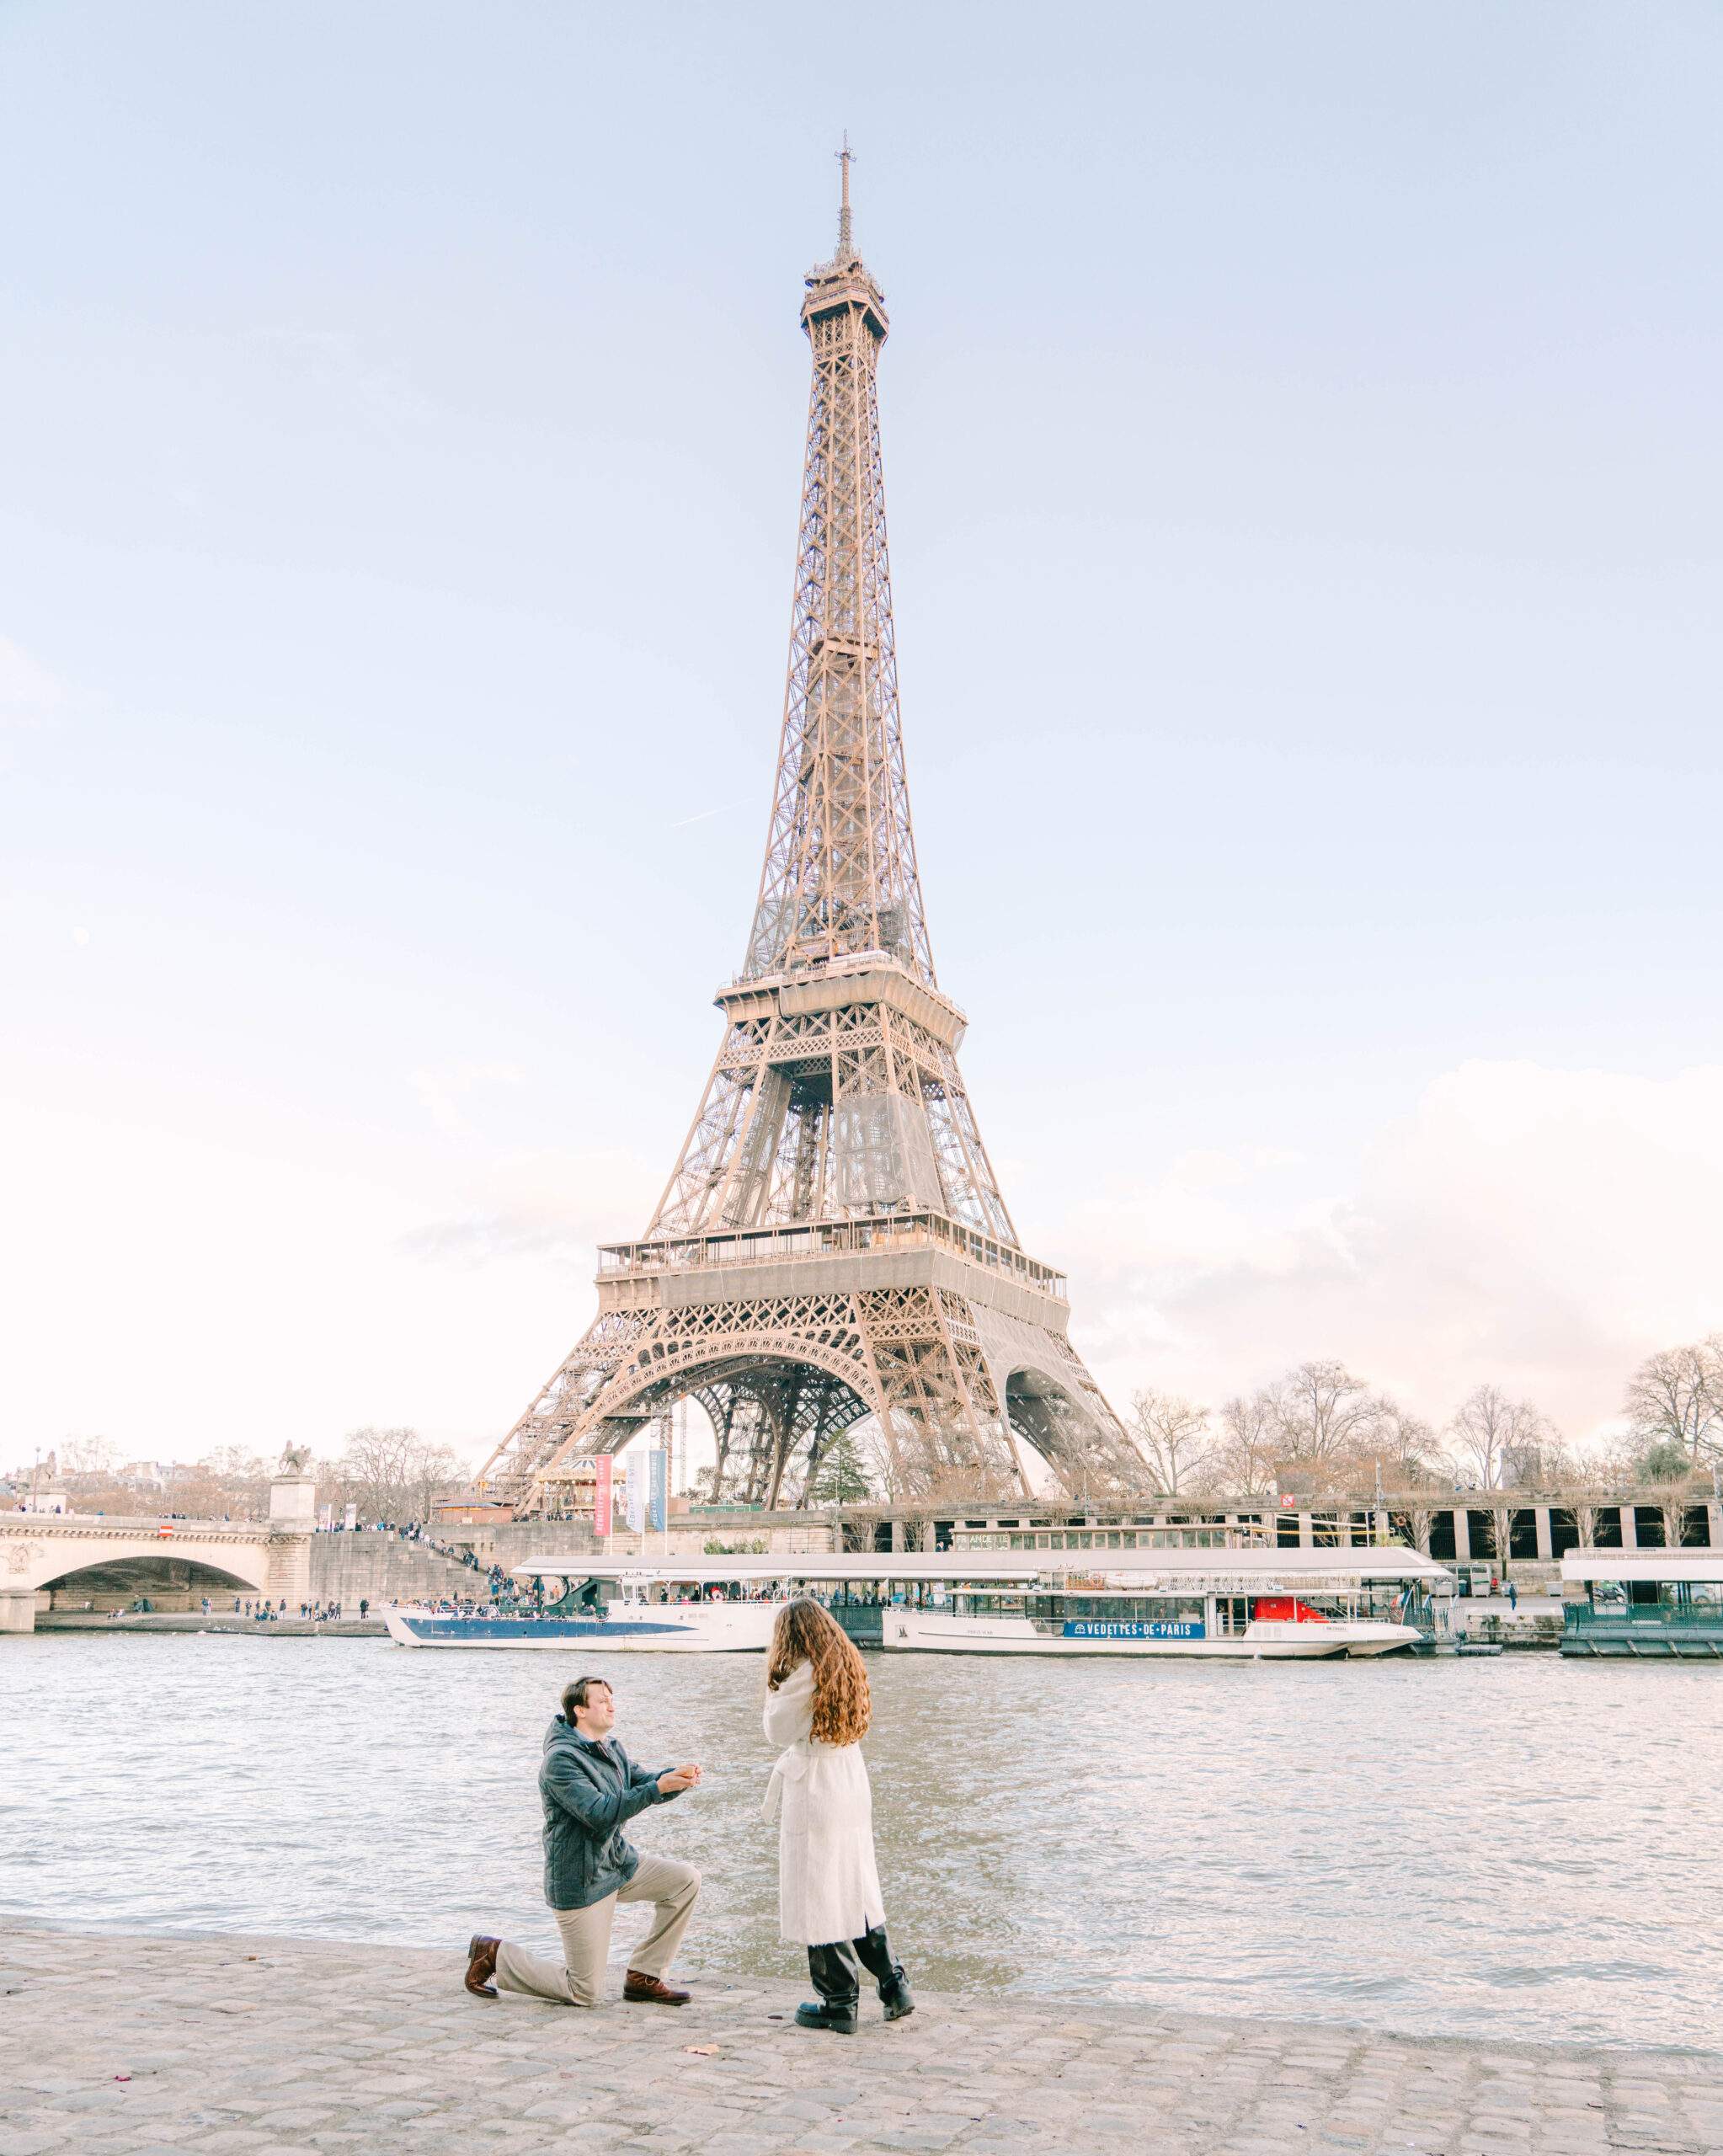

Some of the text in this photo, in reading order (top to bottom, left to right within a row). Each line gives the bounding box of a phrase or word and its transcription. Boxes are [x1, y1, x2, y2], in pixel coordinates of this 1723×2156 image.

[1087, 1624, 1191, 1636] VEDETTES DE PARIS
